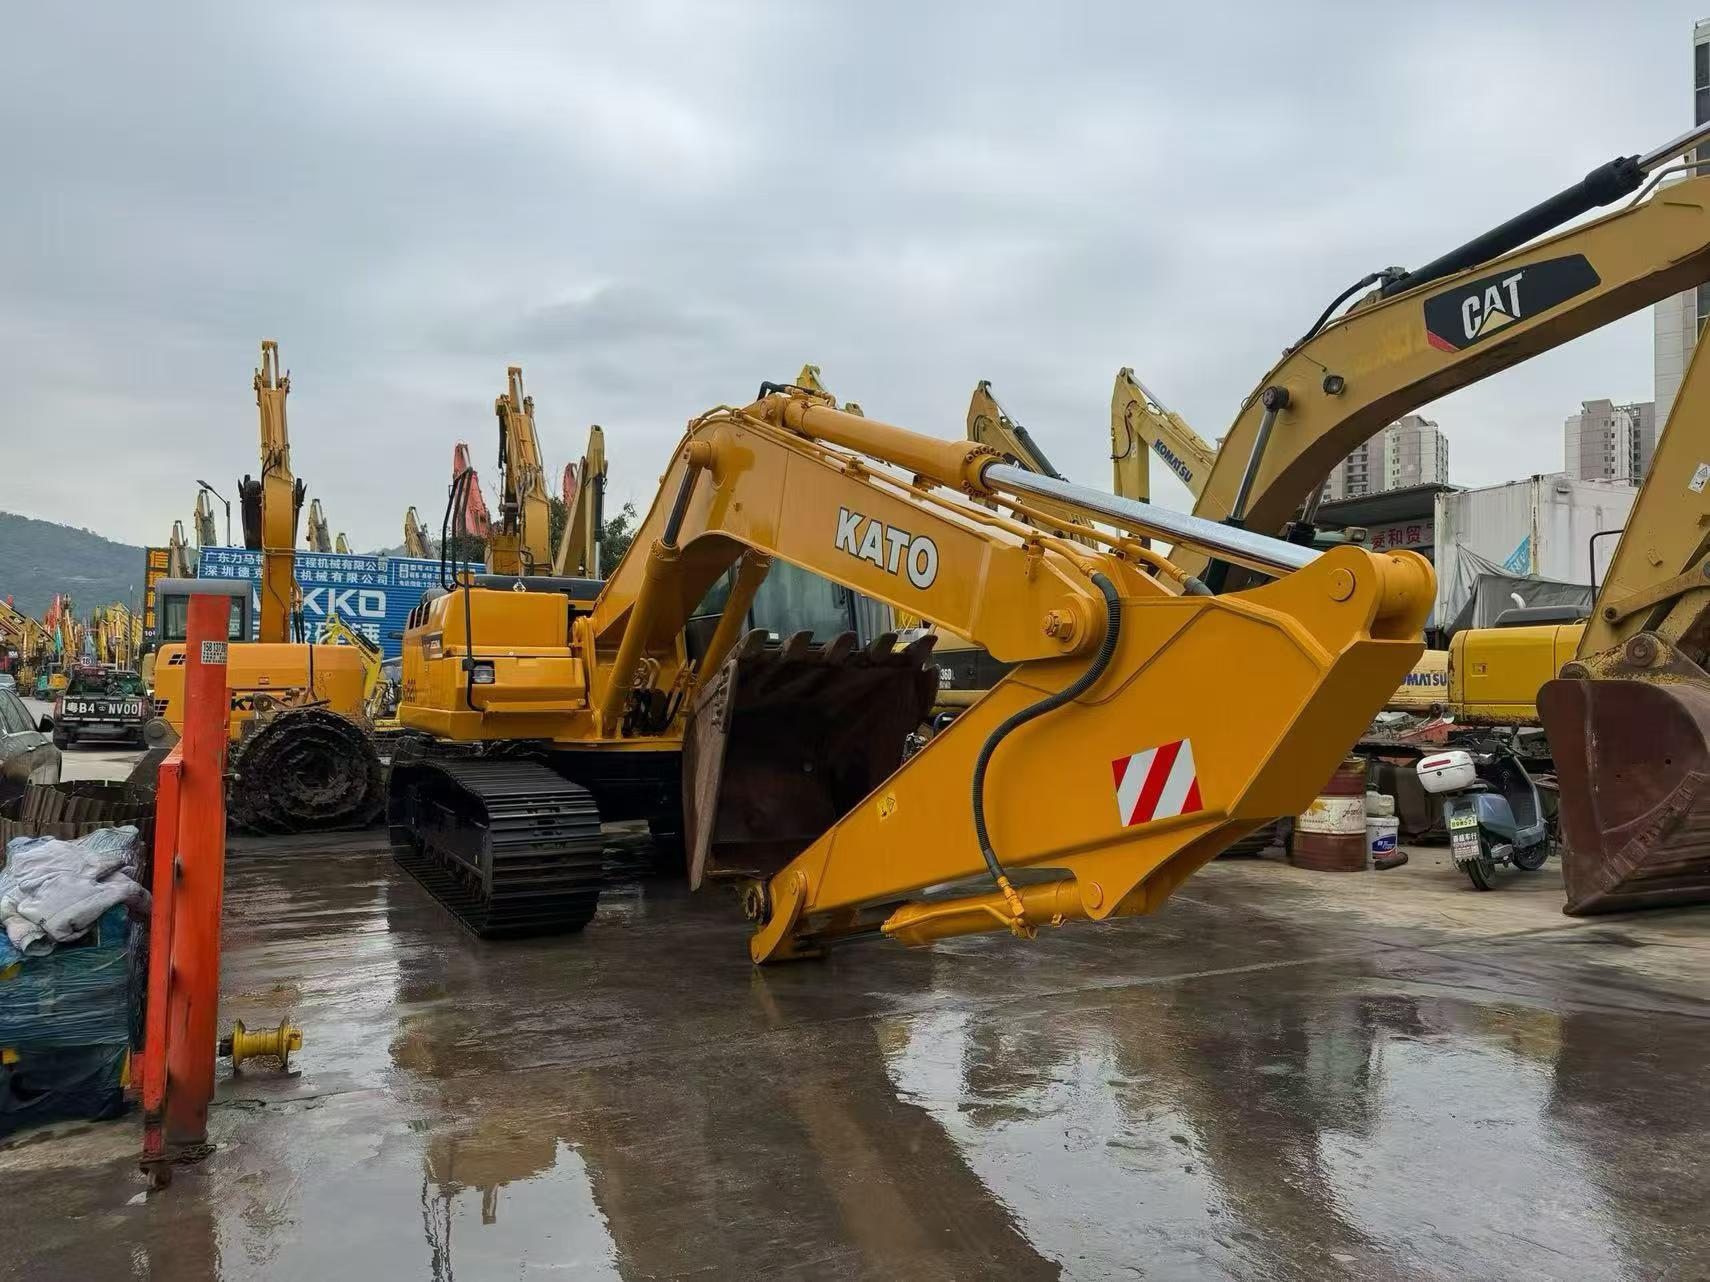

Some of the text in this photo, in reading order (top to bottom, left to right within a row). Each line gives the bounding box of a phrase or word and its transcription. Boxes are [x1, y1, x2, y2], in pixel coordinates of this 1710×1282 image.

[1461, 271, 1523, 340] CAT
[1154, 438, 1193, 483] KOMATSU
[834, 506, 939, 590] KATO
